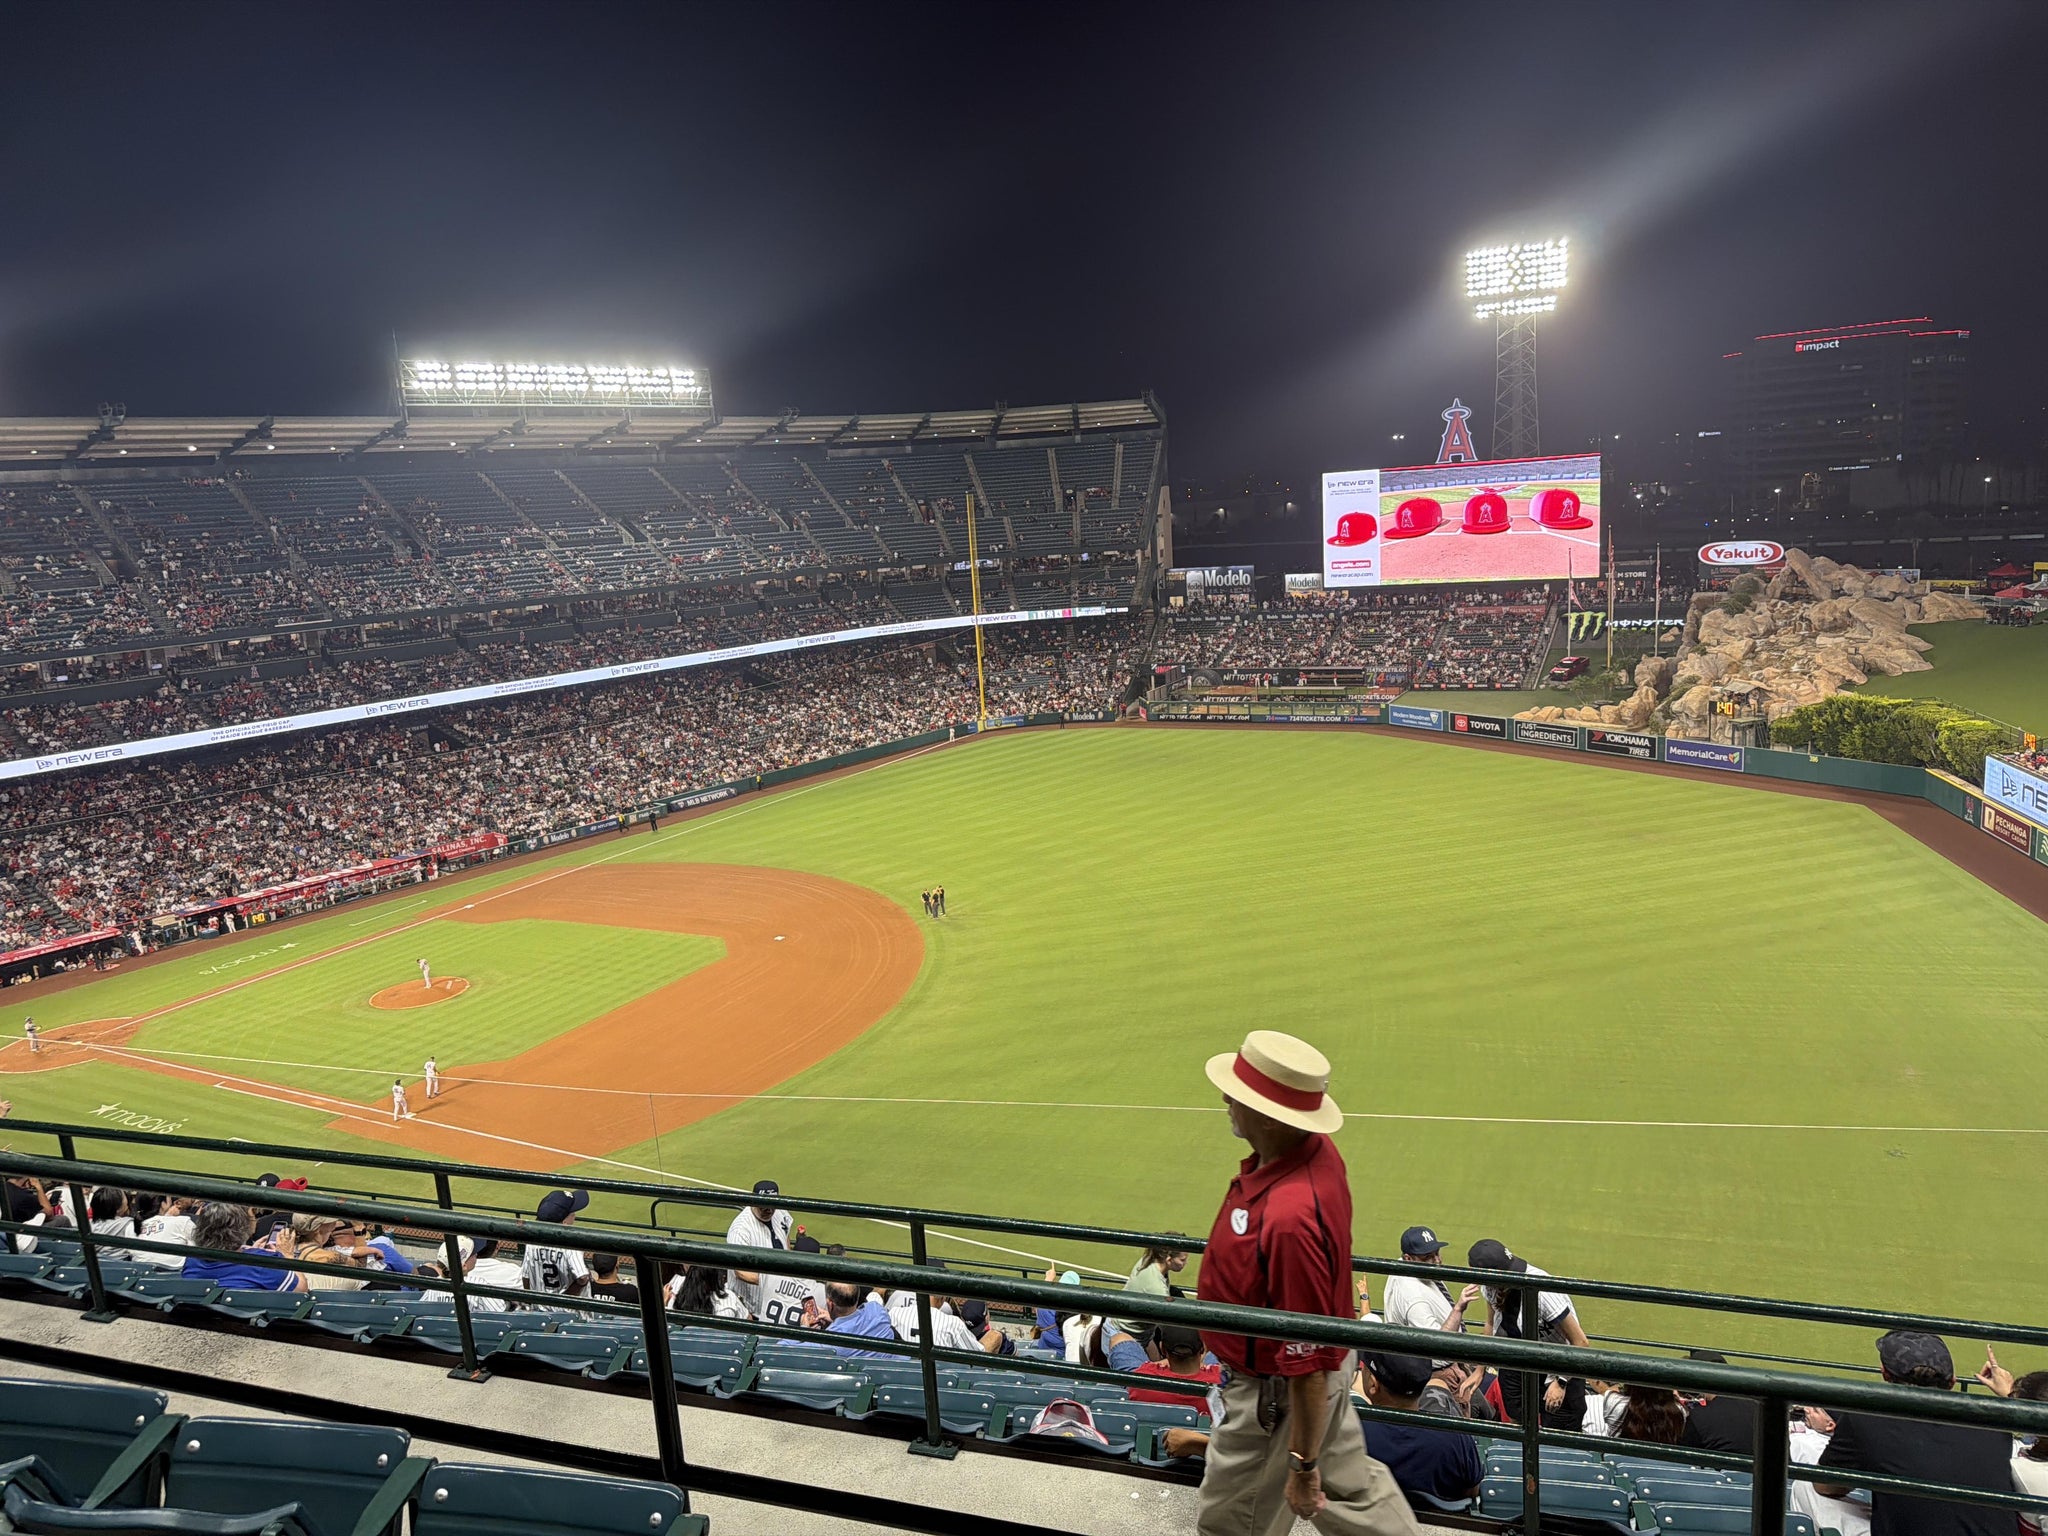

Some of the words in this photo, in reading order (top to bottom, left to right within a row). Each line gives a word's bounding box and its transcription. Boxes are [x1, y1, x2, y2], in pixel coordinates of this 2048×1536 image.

[1803, 340, 1840, 351] impact
[1713, 547, 1770, 559] Yakult
[1204, 570, 1251, 587] Modelo
[1290, 575, 1318, 586] Modelo
[1605, 619, 1685, 627] MONSTER
[1392, 711, 1409, 719] Modern
[1717, 702, 1733, 715] 1:40
[1072, 712, 1095, 721] Modelo
[1469, 720, 1501, 731] TOYOTA
[1520, 729, 1572, 743] INGREDIENTS
[1605, 732, 1651, 747] YOKOHAMA
[1628, 747, 1650, 757] TIRES
[1669, 746, 1729, 762] MemorialCare
[687, 797, 699, 806] MLB
[700, 790, 729, 804] NETWORK
[597, 820, 617, 829] HYUNDAI
[1995, 815, 2027, 839] PECHANGA
[550, 832, 570, 843] Modelo
[1995, 824, 2010, 838] RESORT
[2011, 832, 2027, 847] CASINO
[431, 841, 468, 855] SALINAS,
[470, 836, 487, 846] INC.
[534, 1248, 564, 1264] JETER
[543, 1263, 561, 1287] 2
[775, 1280, 811, 1299] JUDGE
